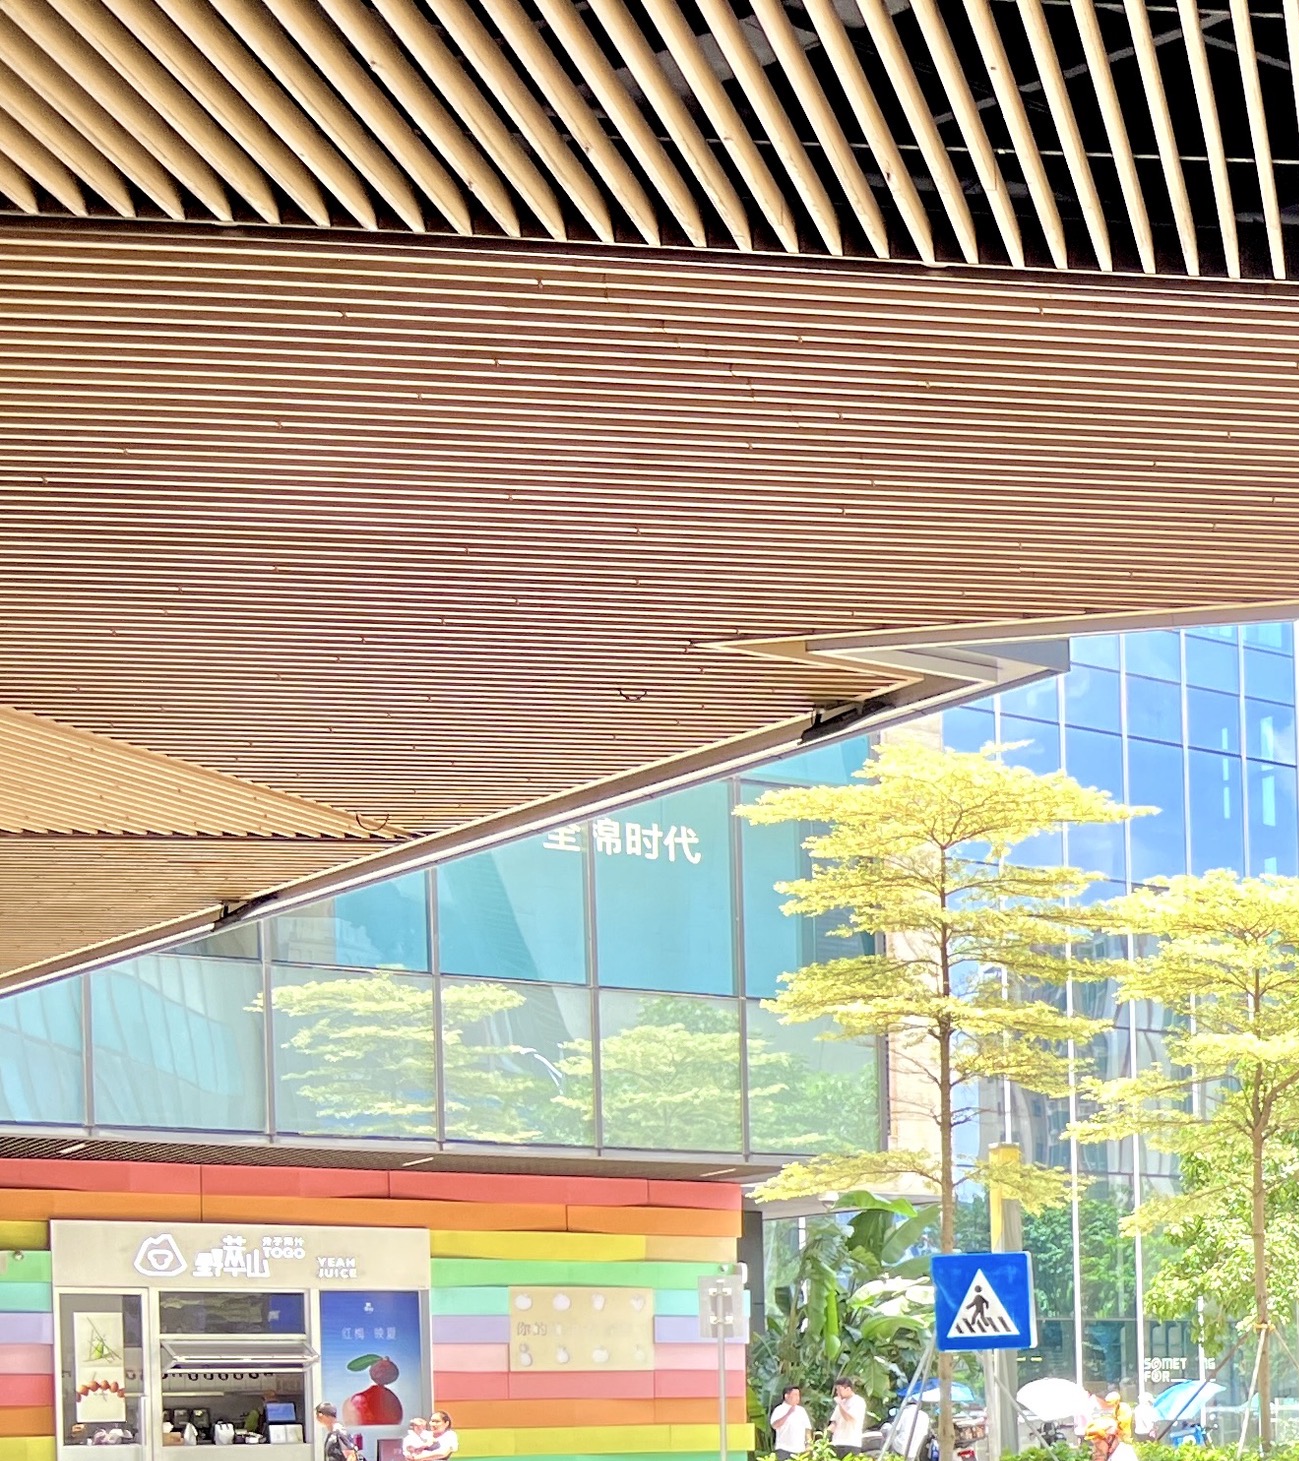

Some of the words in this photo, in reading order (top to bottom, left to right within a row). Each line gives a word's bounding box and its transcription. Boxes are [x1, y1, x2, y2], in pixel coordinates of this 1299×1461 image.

[263, 1246, 305, 1259] TOGO
[317, 1256, 356, 1267] YEAH
[318, 1267, 358, 1278] JUICE
